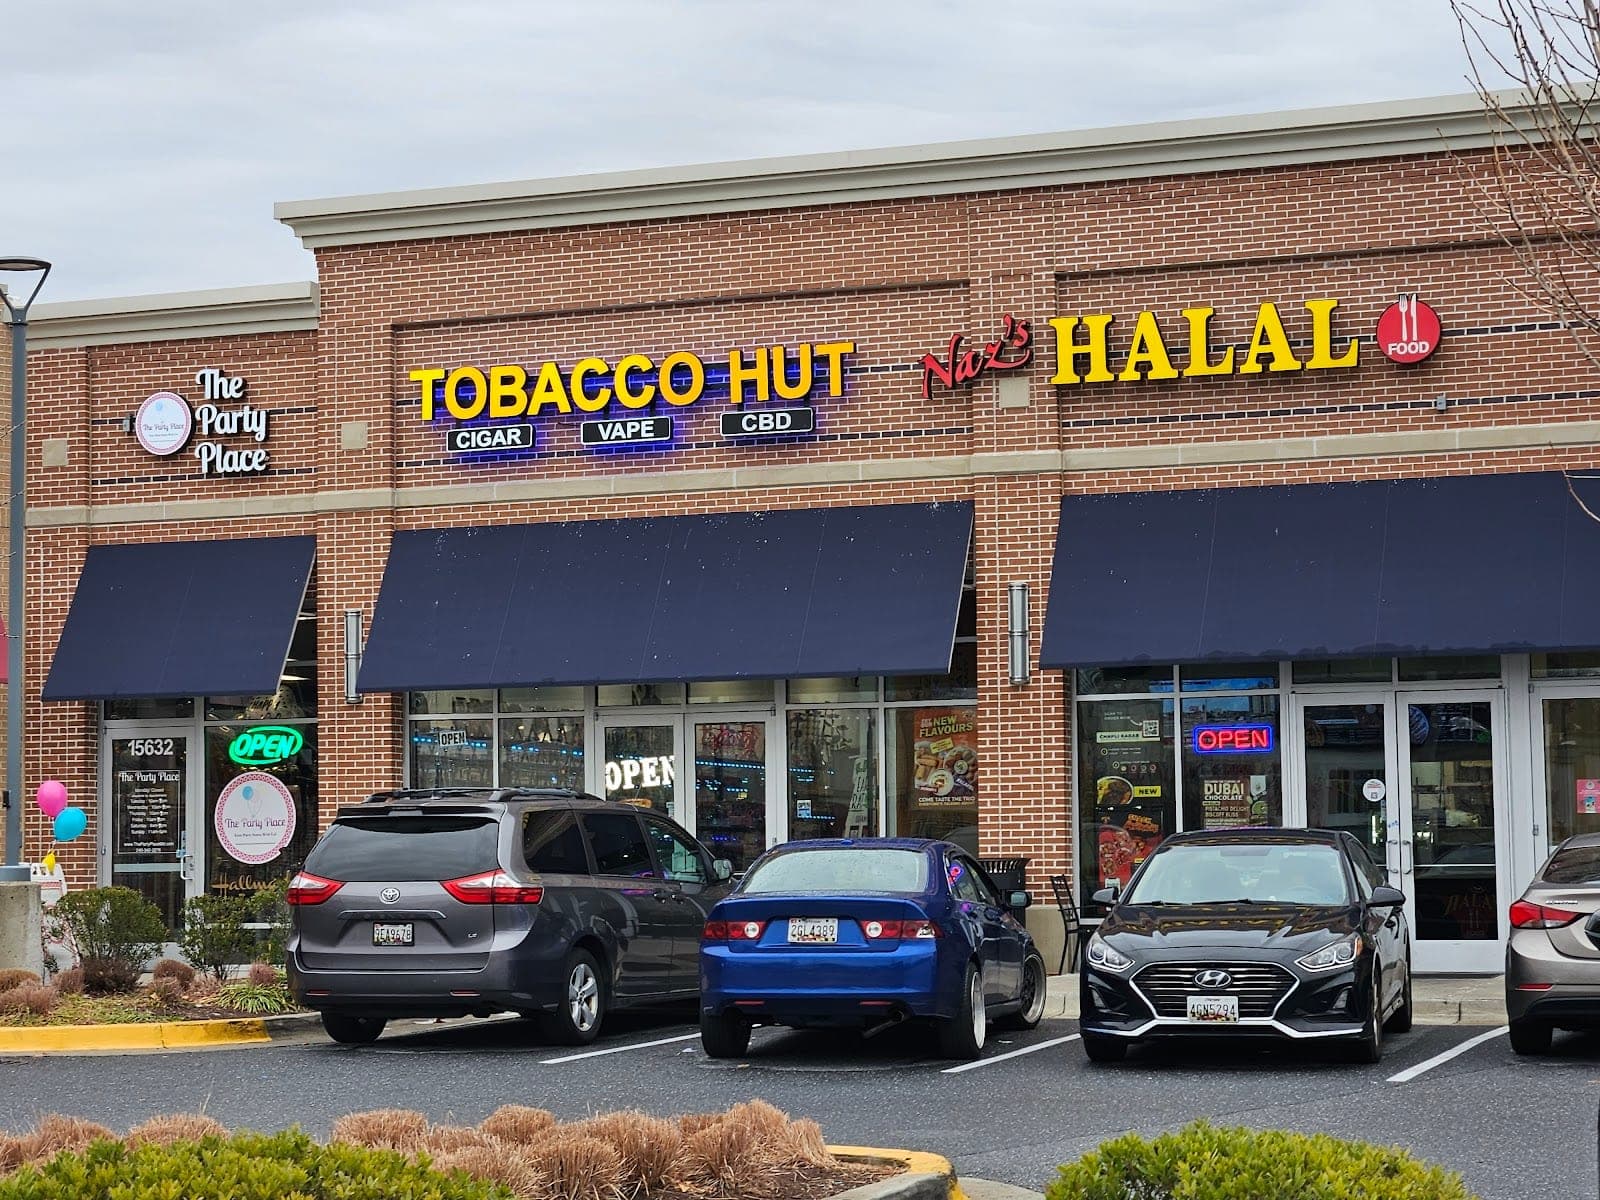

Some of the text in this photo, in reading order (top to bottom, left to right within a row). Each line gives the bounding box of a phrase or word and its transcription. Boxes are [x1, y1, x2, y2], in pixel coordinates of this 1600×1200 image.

[1049, 299, 1360, 385] HALAL
[1387, 341, 1430, 356] FOOD
[917, 313, 1033, 400] Naz's
[195, 368, 245, 400] The
[408, 341, 856, 421] TOBACCO HUT
[195, 404, 267, 442] Party
[597, 420, 655, 440] VAPE
[741, 412, 792, 433] CBD
[455, 430, 522, 450] CIGAR
[194, 441, 268, 474] Place
[919, 722, 973, 738] FLAVOURS
[933, 715, 957, 727] NEW
[127, 738, 174, 757] 15632
[236, 733, 295, 759] OPEN
[441, 731, 465, 746] OPEN
[1198, 729, 1269, 750] OPEN
[119, 770, 180, 785] The Party Place
[604, 754, 675, 791] OPEN
[1138, 788, 1158, 796] NEW
[1204, 783, 1245, 795] DUBAI
[224, 818, 240, 829] The
[241, 818, 263, 830] Party
[791, 924, 836, 938] 2GL4389
[1190, 1003, 1236, 1018] 4GN5294
